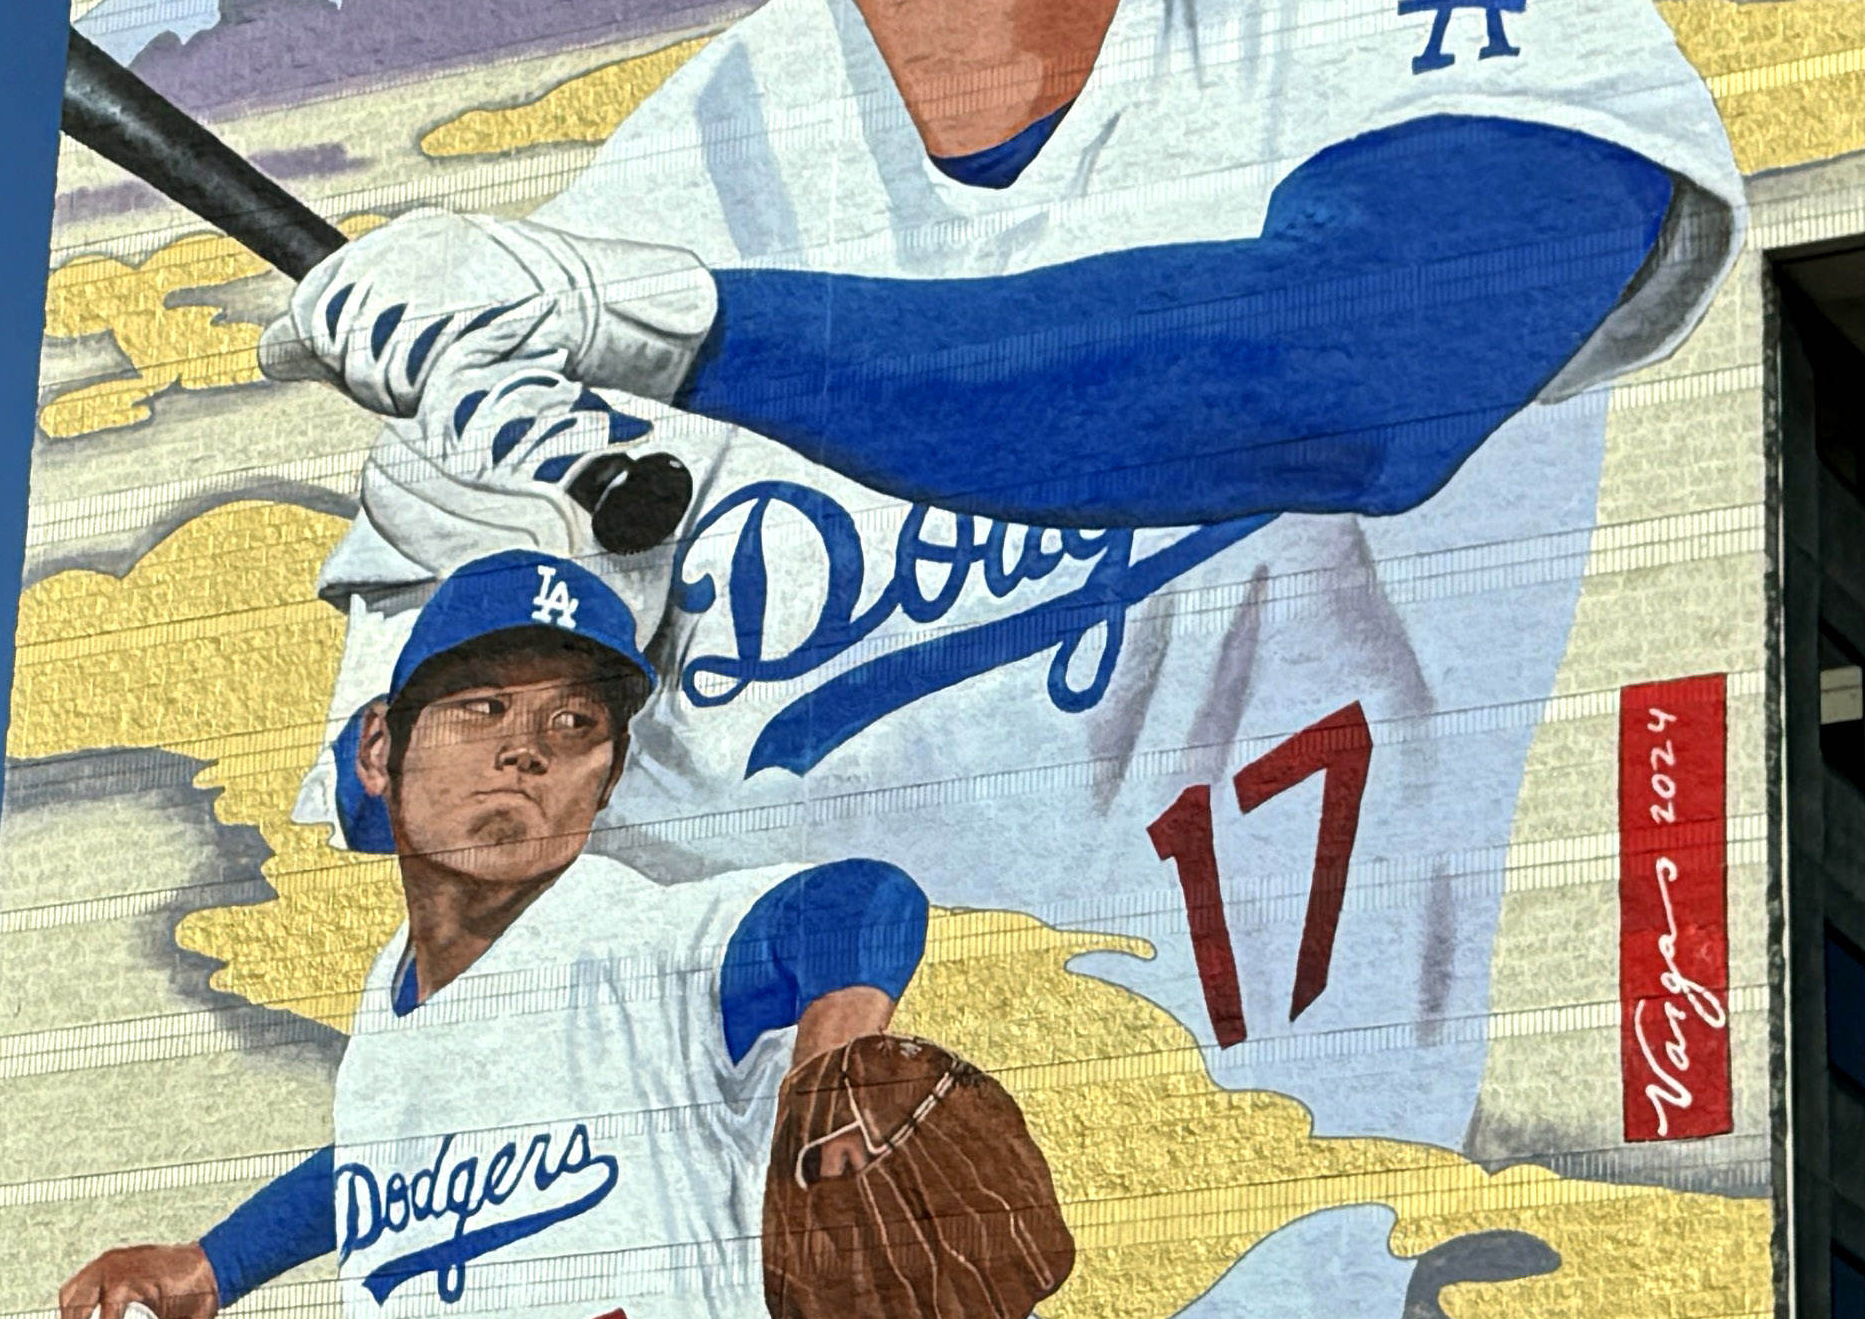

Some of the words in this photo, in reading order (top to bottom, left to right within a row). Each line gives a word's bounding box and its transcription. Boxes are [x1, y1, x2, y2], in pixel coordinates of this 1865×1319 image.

[531, 565, 579, 629] LA
[1648, 707, 1677, 825] 2024
[1146, 700, 1374, 1049] 17
[334, 1124, 618, 1305] Dodgers
